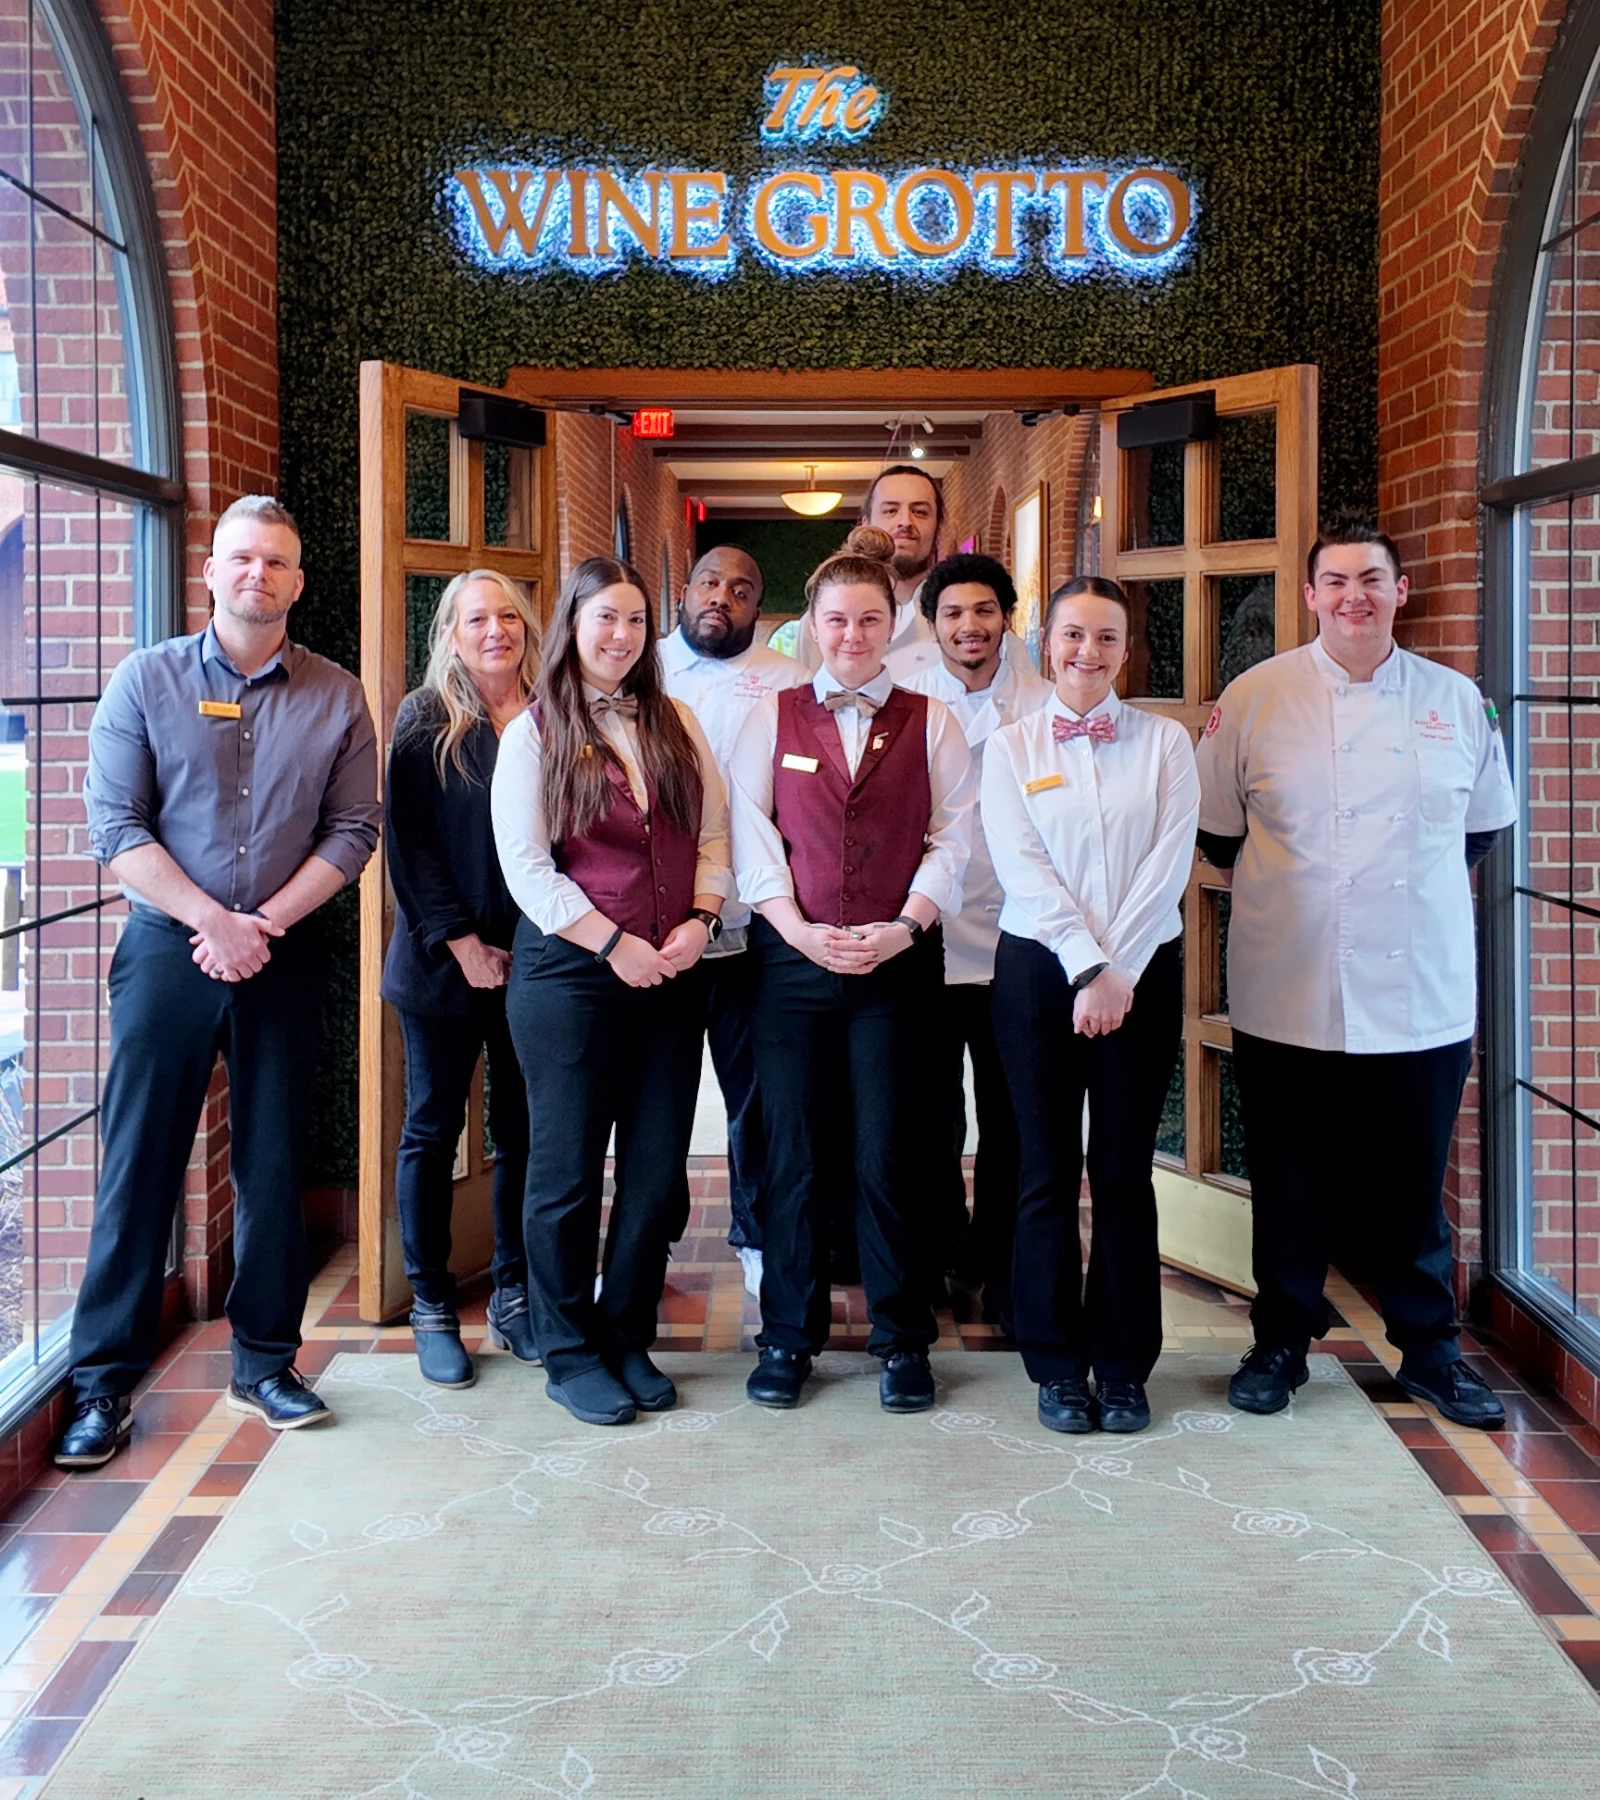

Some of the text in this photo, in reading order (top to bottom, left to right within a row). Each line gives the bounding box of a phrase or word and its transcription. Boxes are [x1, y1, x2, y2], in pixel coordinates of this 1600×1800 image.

[767, 67, 879, 130] The
[456, 169, 1190, 257] WINE GROTTO
[641, 411, 670, 434] EXIT
